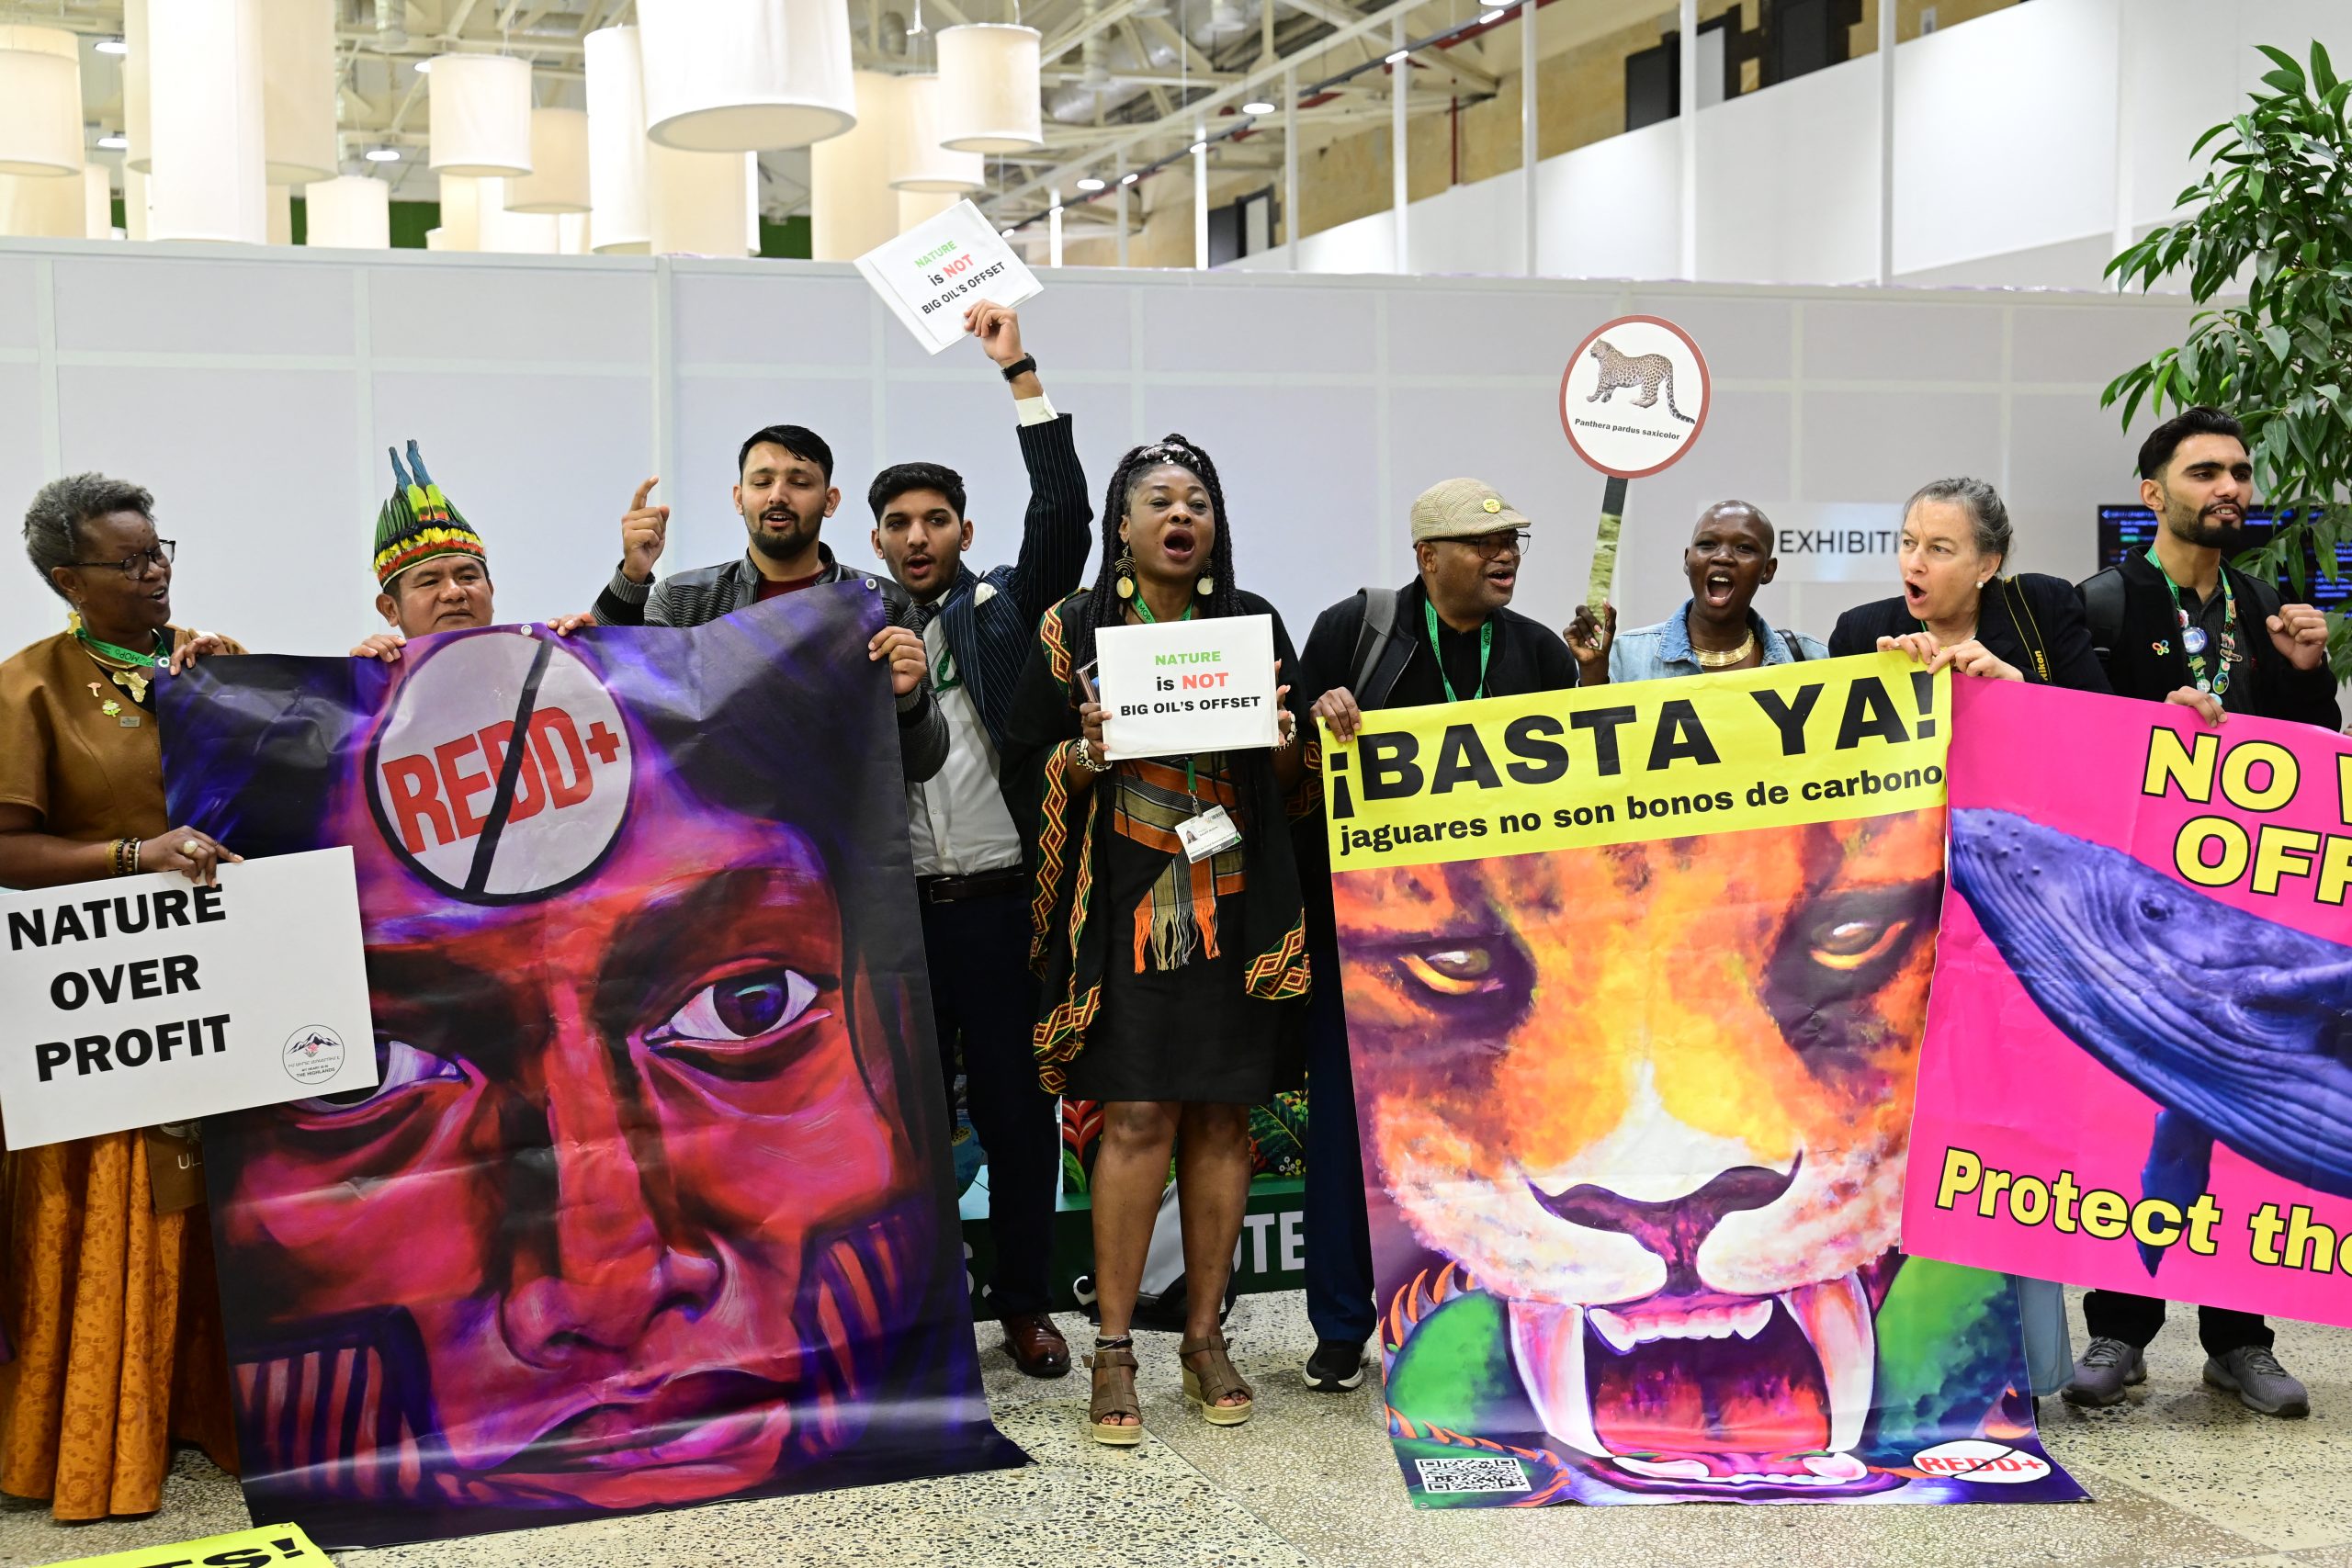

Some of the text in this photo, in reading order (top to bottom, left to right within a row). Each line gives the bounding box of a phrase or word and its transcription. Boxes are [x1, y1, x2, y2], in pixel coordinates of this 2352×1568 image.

[914, 240, 958, 268] NATURE
[927, 254, 977, 287] is NOT
[921, 261, 1006, 314] BIG OIL'S OFFSET
[1574, 418, 1679, 440] Panthera pardus saxicolor
[1155, 651, 1222, 666] NATURE
[1156, 672, 1229, 692] is NOT
[1120, 696, 1261, 716] BIG OIL'S OFFSET
[1329, 671, 1937, 819] ¡BASTA YA!
[2142, 727, 2301, 813] NO
[381, 706, 621, 855] REDD+
[1340, 762, 1943, 856] jaguares no son bonos de carbono
[2174, 815, 2352, 908] OFF
[7, 883, 226, 951] NATURE
[50, 954, 201, 1010] OVER
[35, 1013, 231, 1082] PROFIT
[1936, 1146, 2222, 1258] Protect
[1232, 1210, 1306, 1274] TE
[1917, 1456, 2044, 1472] REDD+
